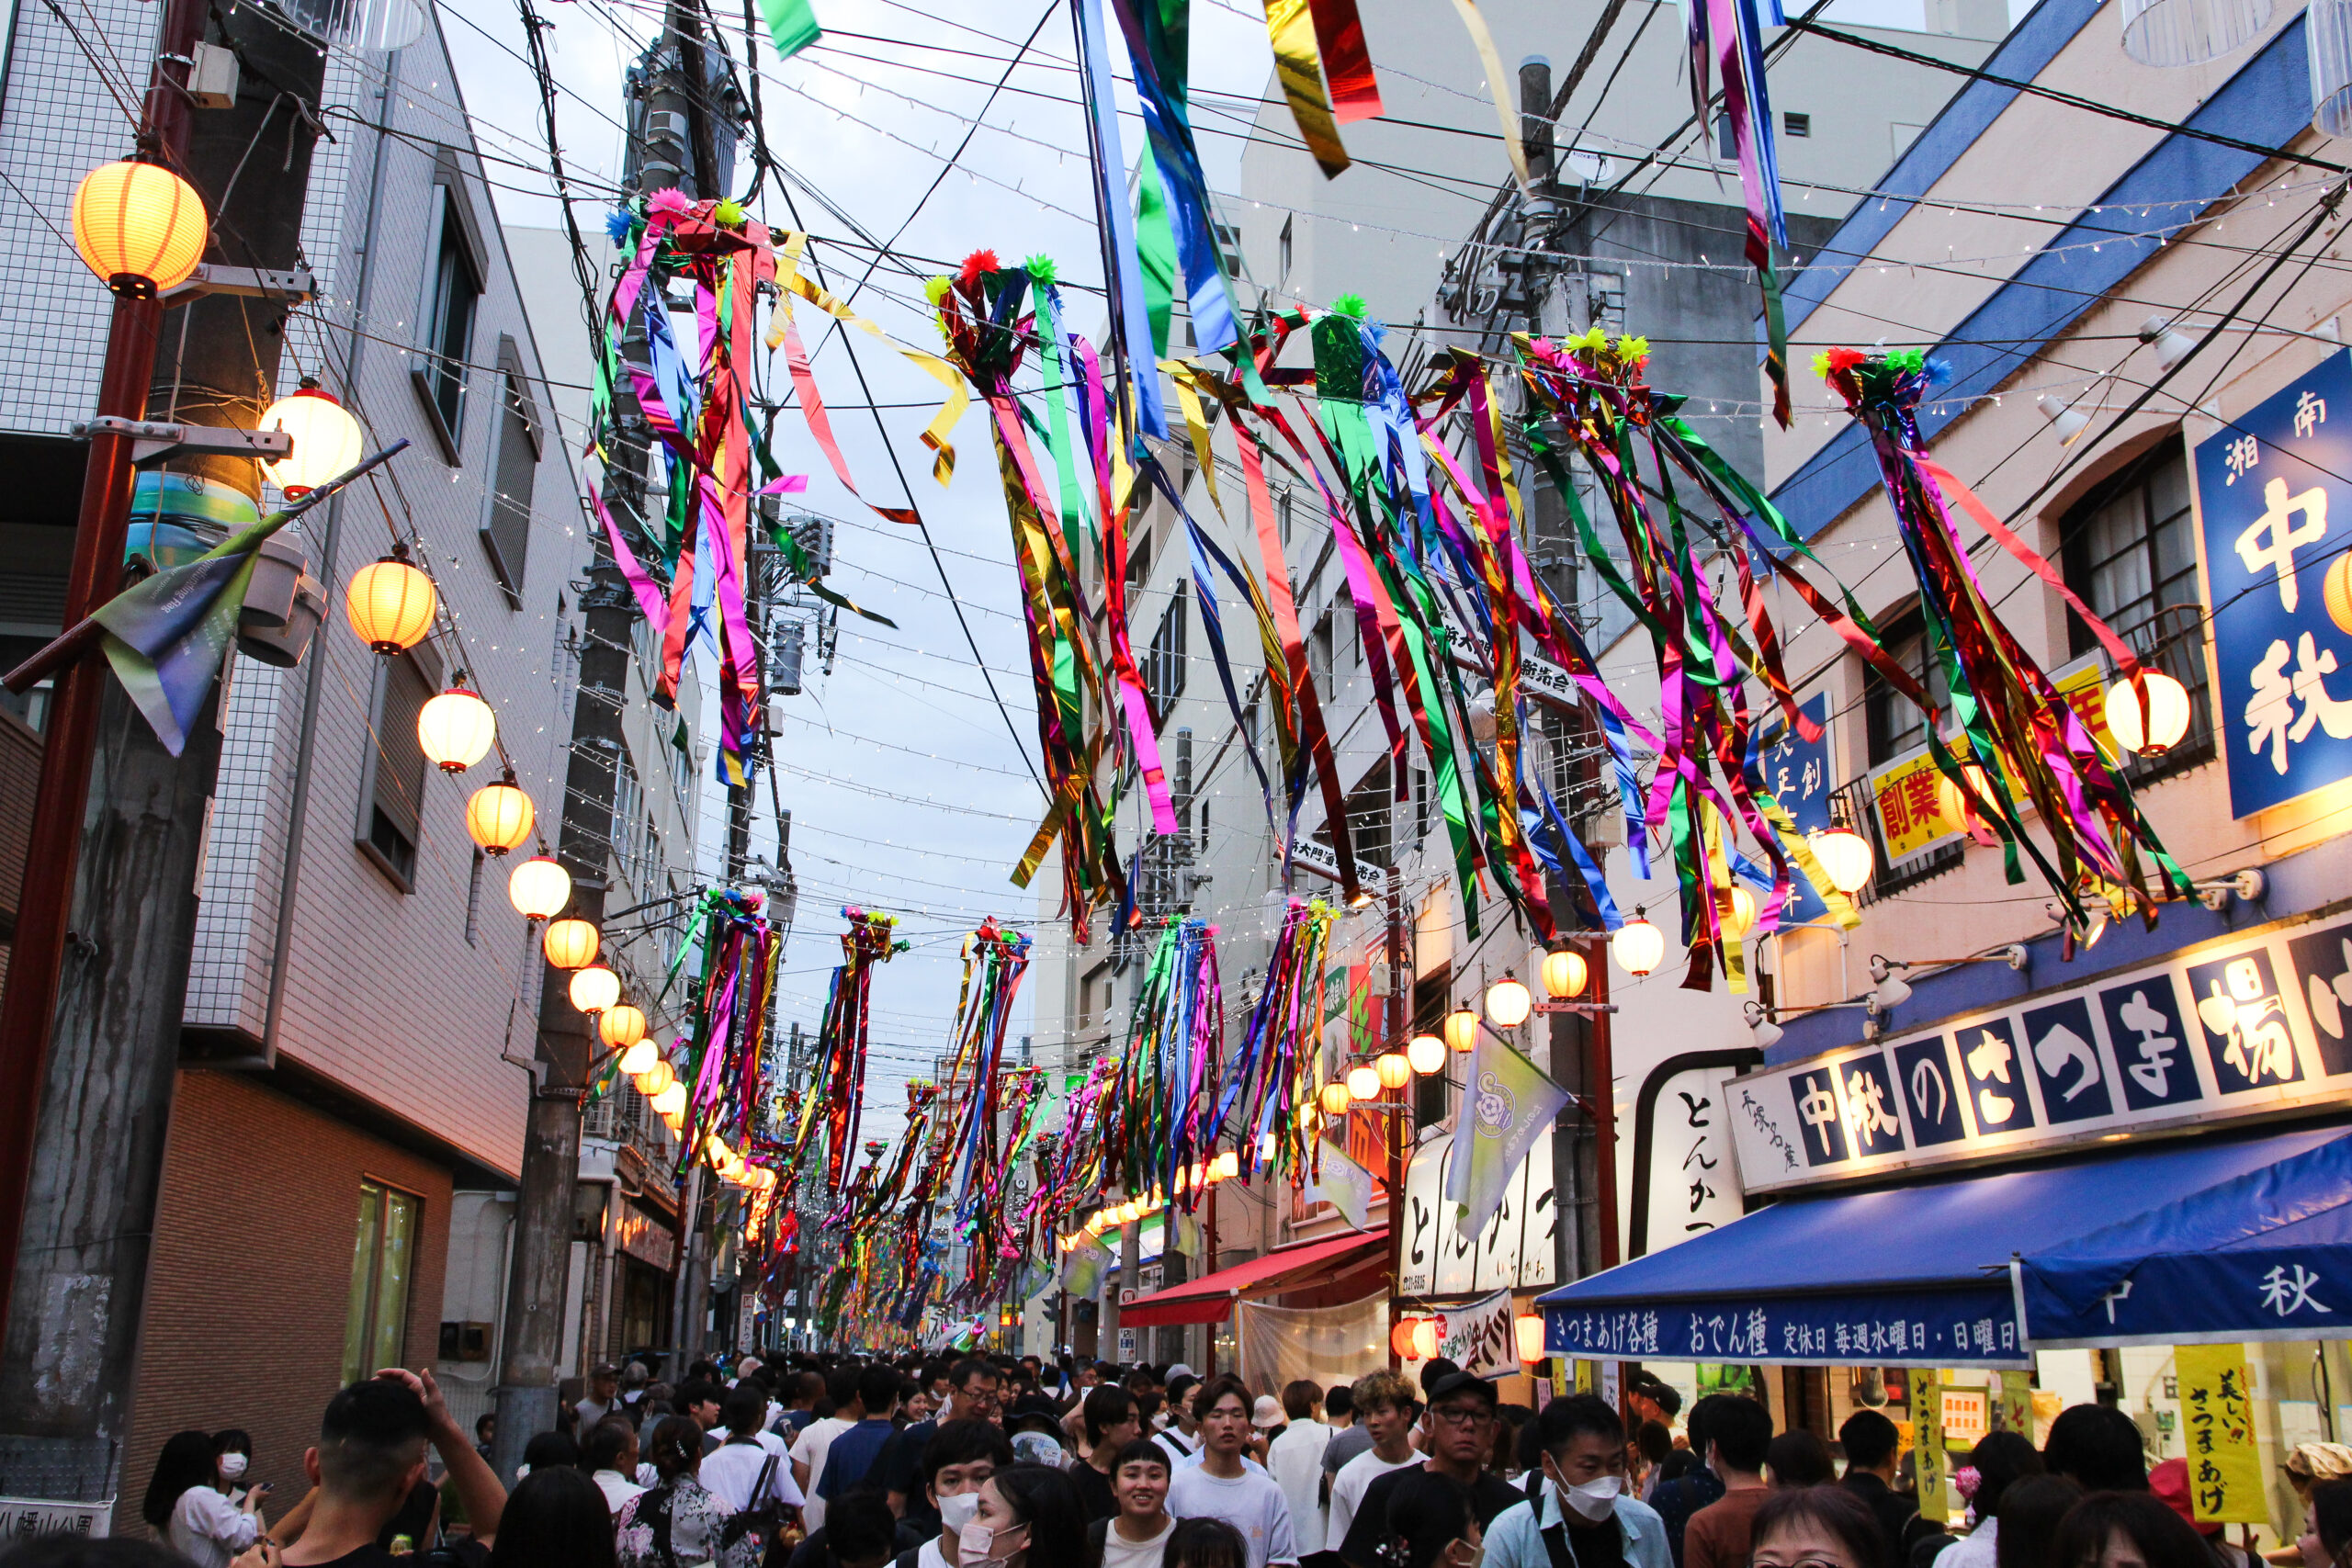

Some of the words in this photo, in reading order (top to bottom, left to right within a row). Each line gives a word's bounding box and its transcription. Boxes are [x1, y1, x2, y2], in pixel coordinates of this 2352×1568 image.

[2224, 390, 2326, 487] 湘南
[2234, 476, 2352, 777] 中秋
[1879, 766, 1940, 840] 創業
[1741, 1089, 1800, 1174] 平塚名産
[1555, 1310, 1659, 1354] さつまあげ各種
[1690, 1306, 1769, 1357] おでん種
[1782, 1325, 1826, 1355] 定休日
[1917, 1377, 1938, 1495] さつまあげ
[2189, 1387, 2228, 1515] さつまあげ
